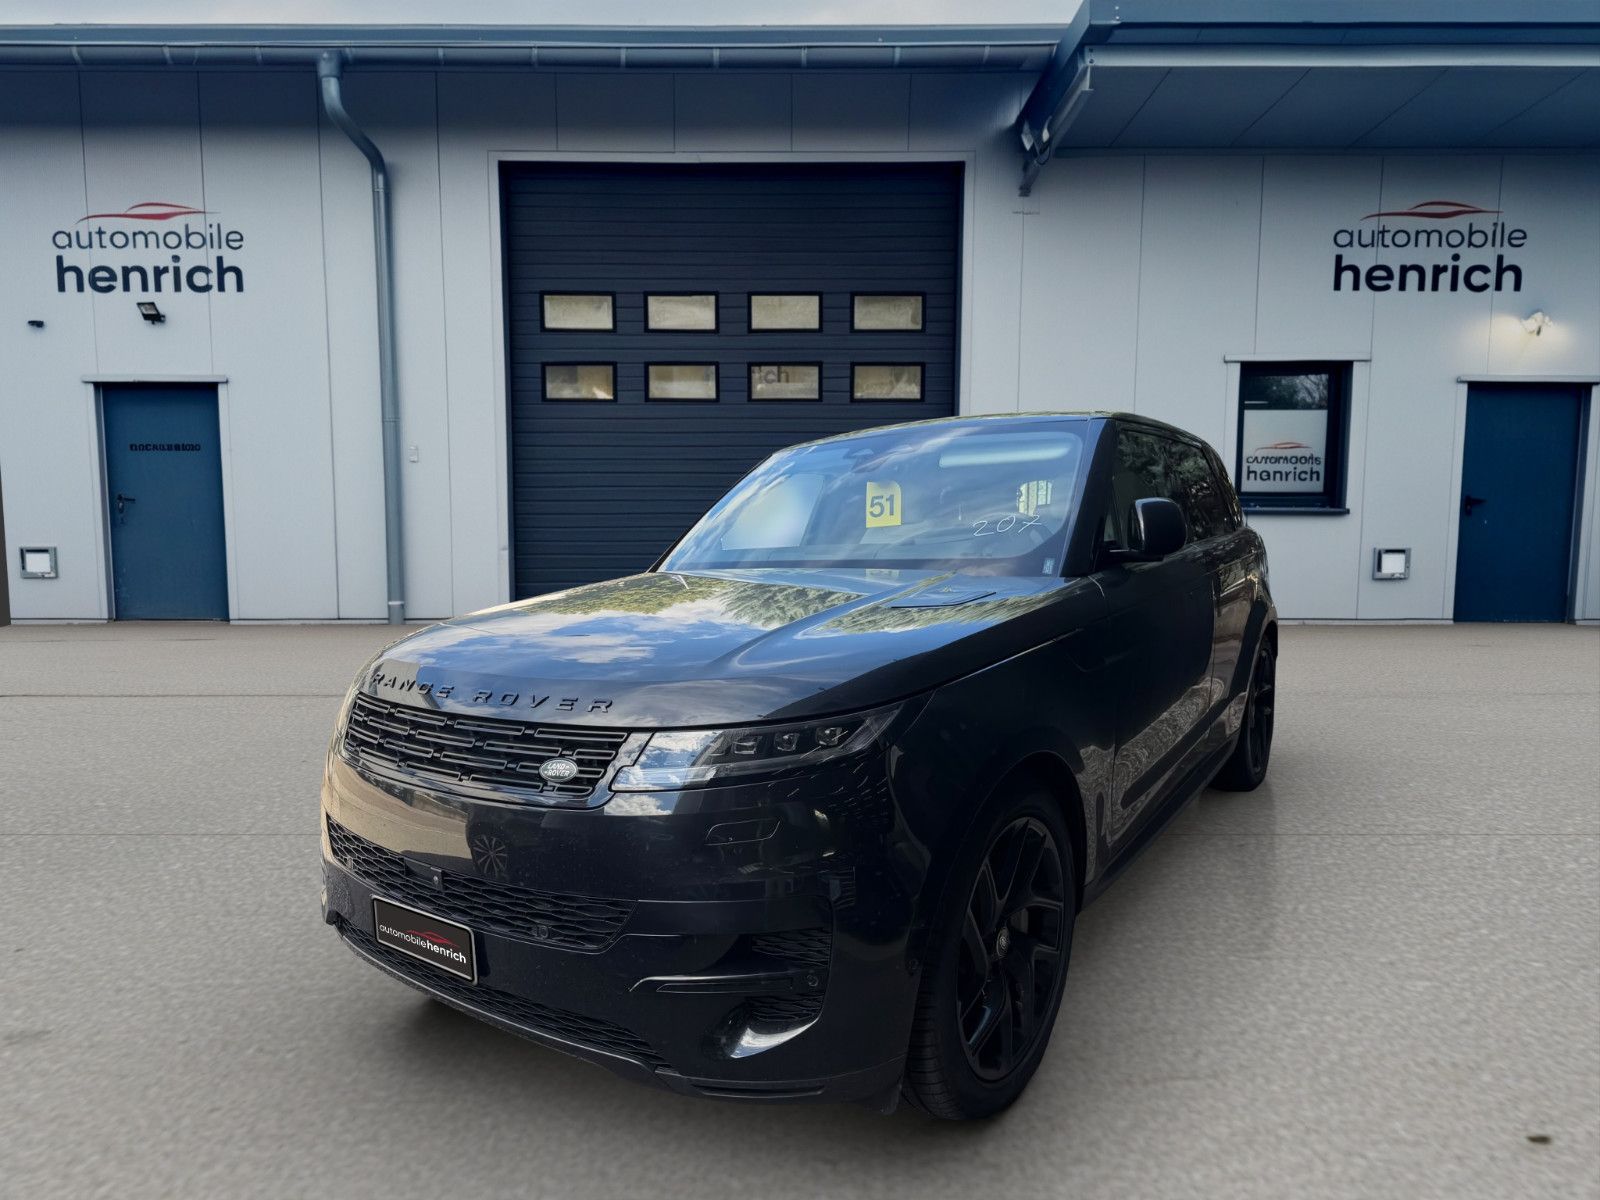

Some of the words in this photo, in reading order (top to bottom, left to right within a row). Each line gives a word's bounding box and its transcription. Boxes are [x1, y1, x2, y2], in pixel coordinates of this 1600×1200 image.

[52, 223, 244, 250] automobile
[1333, 222, 1528, 248] automobile
[56, 255, 244, 293] henrich
[1333, 253, 1523, 293] henrich
[869, 494, 895, 518] 51
[371, 672, 454, 698] RANGE
[473, 690, 613, 713] ROVER
